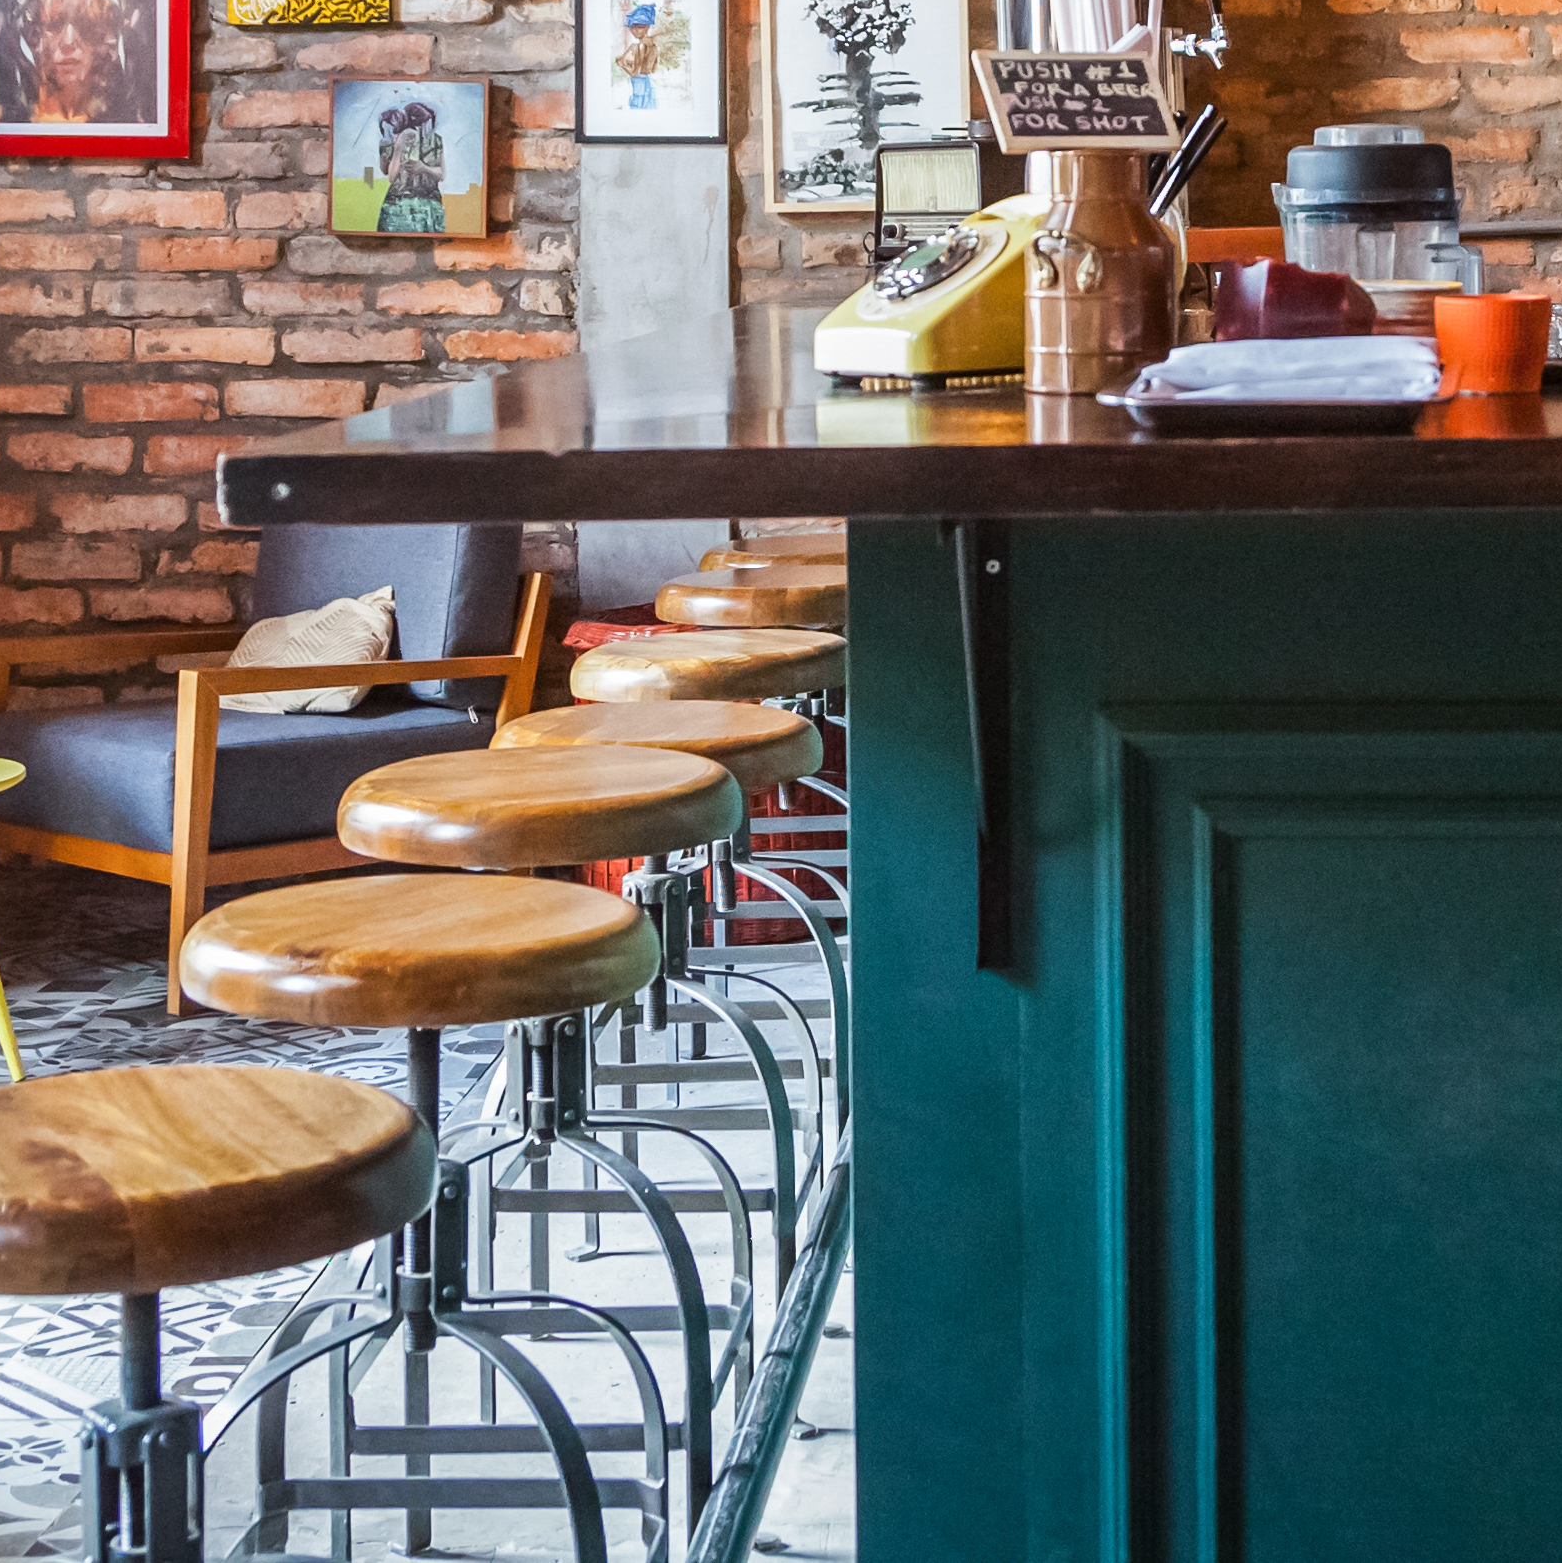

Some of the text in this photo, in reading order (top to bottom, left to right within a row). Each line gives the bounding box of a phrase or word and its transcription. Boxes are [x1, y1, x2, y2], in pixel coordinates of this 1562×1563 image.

[998, 61, 1072, 80] PUSH
[1014, 81, 1071, 97] FOR
[1011, 113, 1149, 132] FOR SHOT
